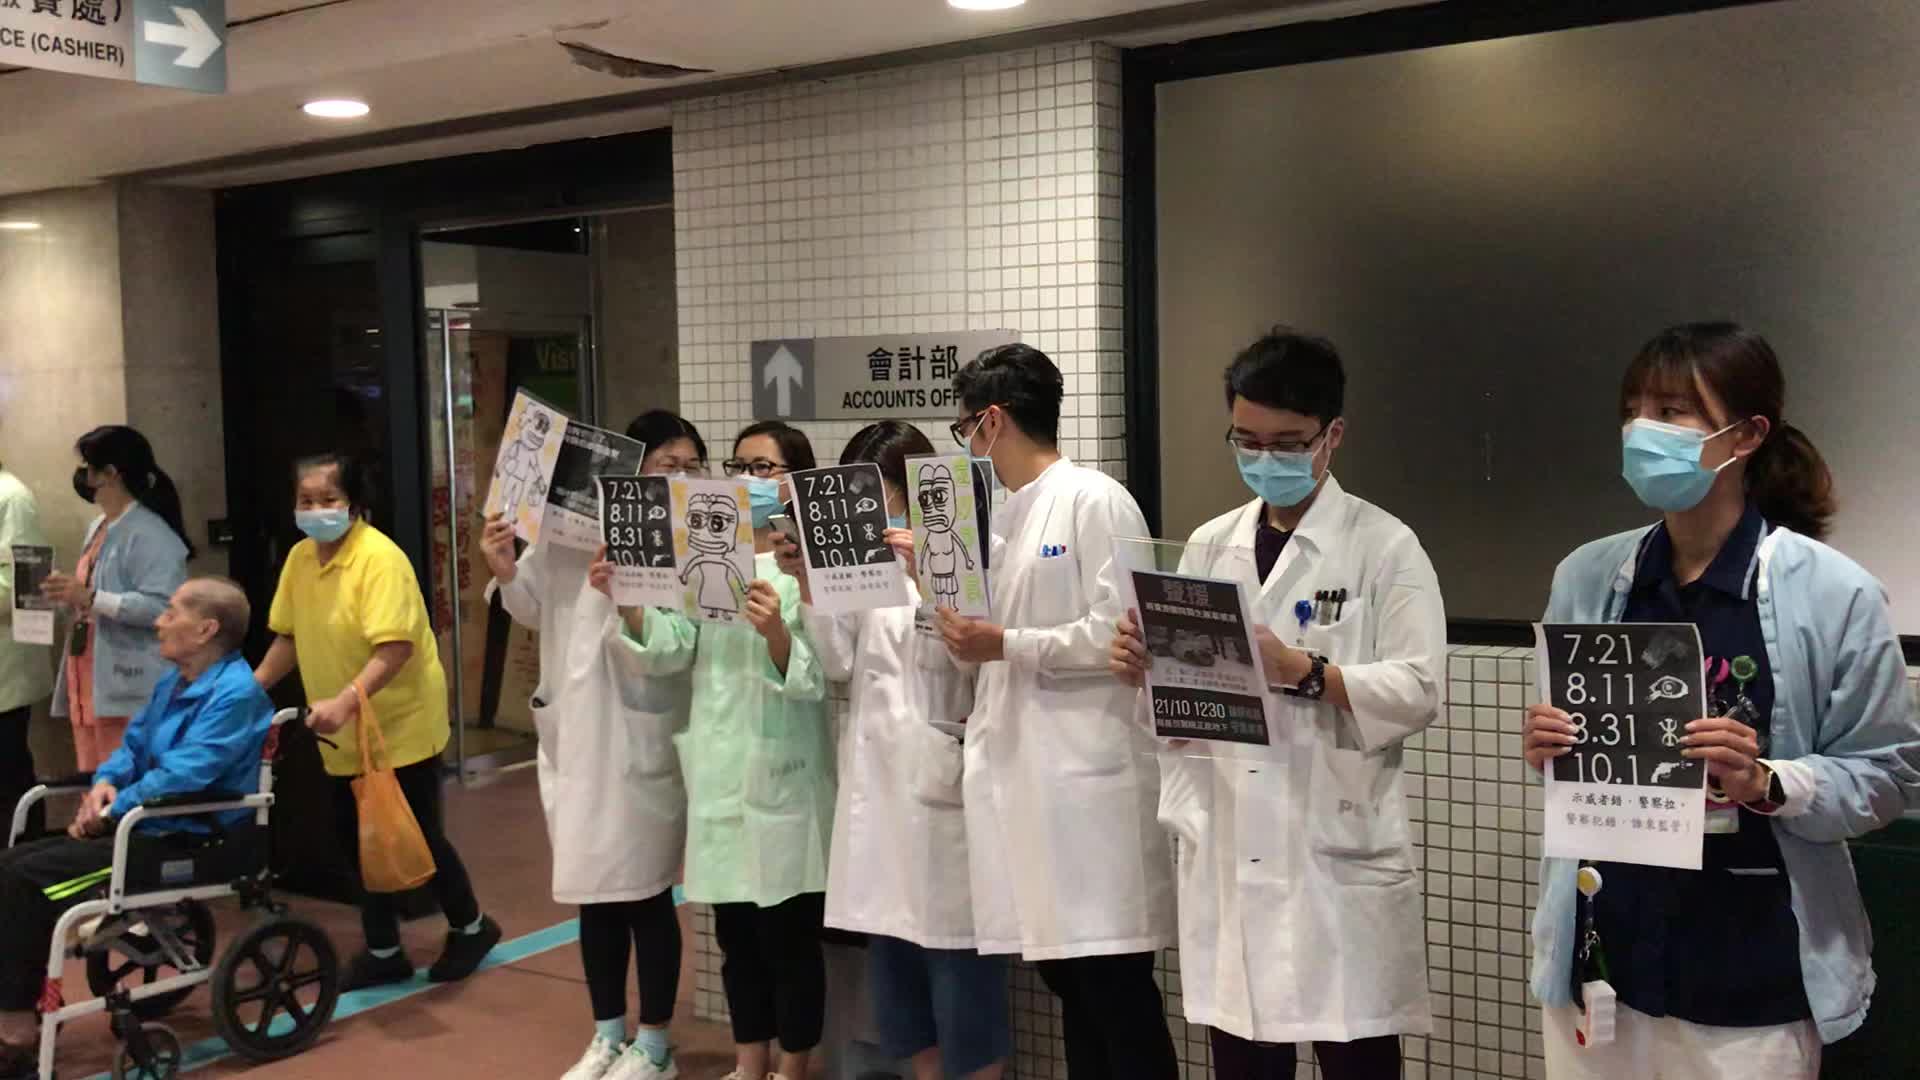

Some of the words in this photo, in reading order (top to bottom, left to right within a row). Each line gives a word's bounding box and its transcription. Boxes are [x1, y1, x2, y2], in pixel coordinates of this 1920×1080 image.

[31, 32, 125, 67] (CASHIER)
[867, 345, 960, 382] 會計部
[842, 389, 926, 410] ACCOUNTS
[608, 481, 643, 500] 7.21
[804, 474, 845, 497] 7.21
[610, 503, 643, 523] 8.11
[809, 499, 849, 522] 8.11
[610, 527, 644, 547] 8.31
[813, 524, 853, 546] 8.31
[614, 550, 648, 567] 10.1
[820, 548, 860, 568] 10.1
[1563, 633, 1632, 665] 7.21
[1566, 672, 1634, 706] 8.11
[1155, 698, 1191, 717] 21/10
[1194, 701, 1226, 719] 1230
[1568, 712, 1636, 746] 8.31
[1573, 753, 1638, 786] 10.1
